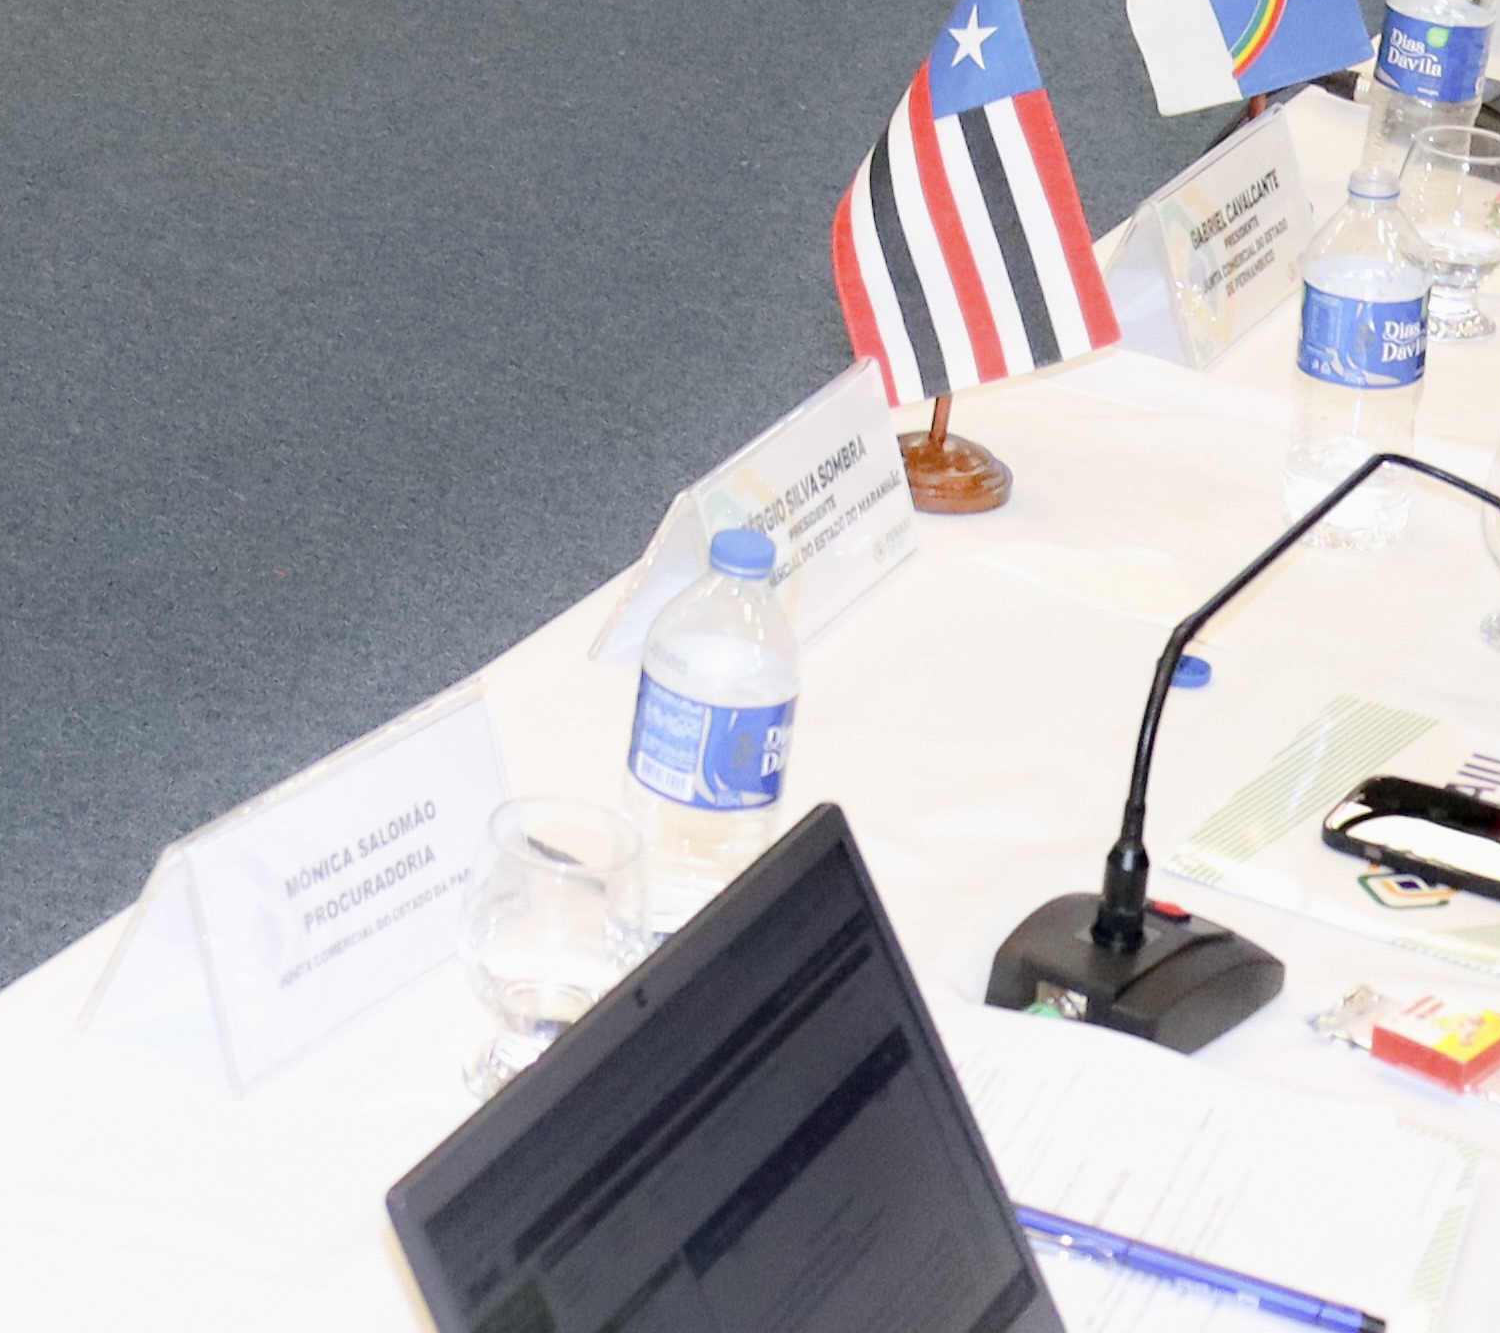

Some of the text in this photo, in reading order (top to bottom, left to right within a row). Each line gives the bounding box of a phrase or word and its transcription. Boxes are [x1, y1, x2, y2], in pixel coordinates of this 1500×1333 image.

[1389, 27, 1426, 54] Dias
[1189, 167, 1281, 252] GABRIEL CAVALCANTE
[1223, 213, 1260, 250] PRESIDENTE
[1221, 243, 1257, 279] COMERCIAL
[1255, 235, 1266, 252] DO
[1263, 216, 1289, 247] ESTADO
[1233, 247, 1277, 291] PERNAMBUCO
[742, 433, 868, 535] ÉRGIO SILVA SOMBRA
[787, 493, 838, 543] PRESIDENTE
[800, 542, 815, 564] DO
[813, 516, 847, 554] ESTADO
[845, 507, 860, 528] DO
[284, 798, 438, 900] MÔNICA SALOMÃO
[303, 844, 436, 935] PROCURADORIA
[313, 923, 375, 968] COMERCIAL
[376, 915, 393, 932] DO
[391, 889, 435, 924] ESTADO
[433, 880, 450, 900] DA
